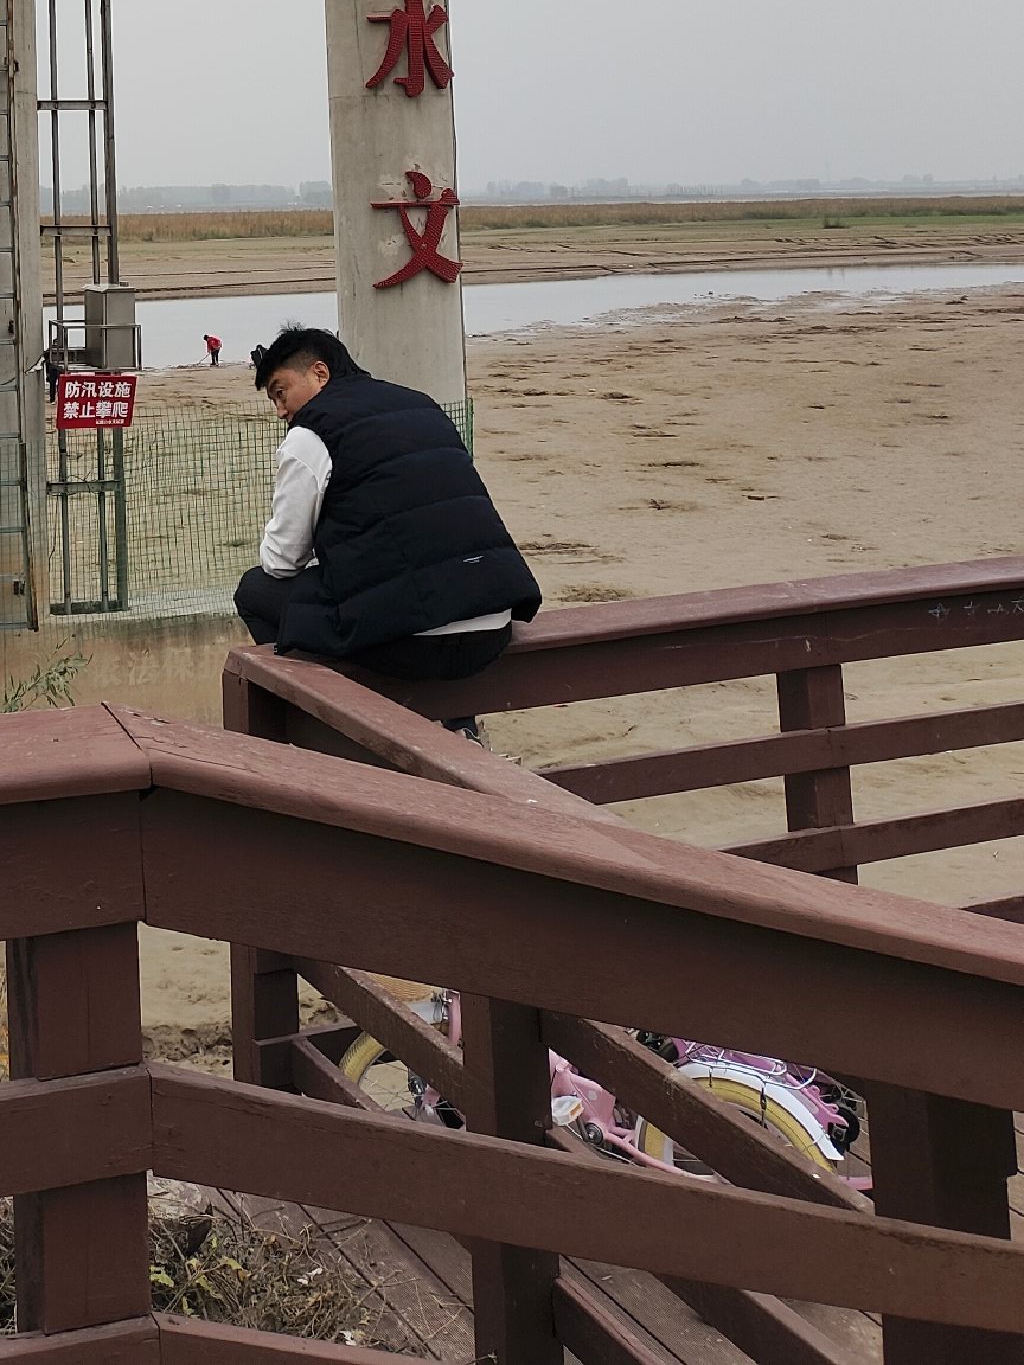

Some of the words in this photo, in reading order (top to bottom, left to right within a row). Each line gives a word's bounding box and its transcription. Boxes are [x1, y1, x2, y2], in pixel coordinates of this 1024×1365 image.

[64, 381, 132, 398] 防汛设施
[63, 401, 129, 419] 禁止攀爬
